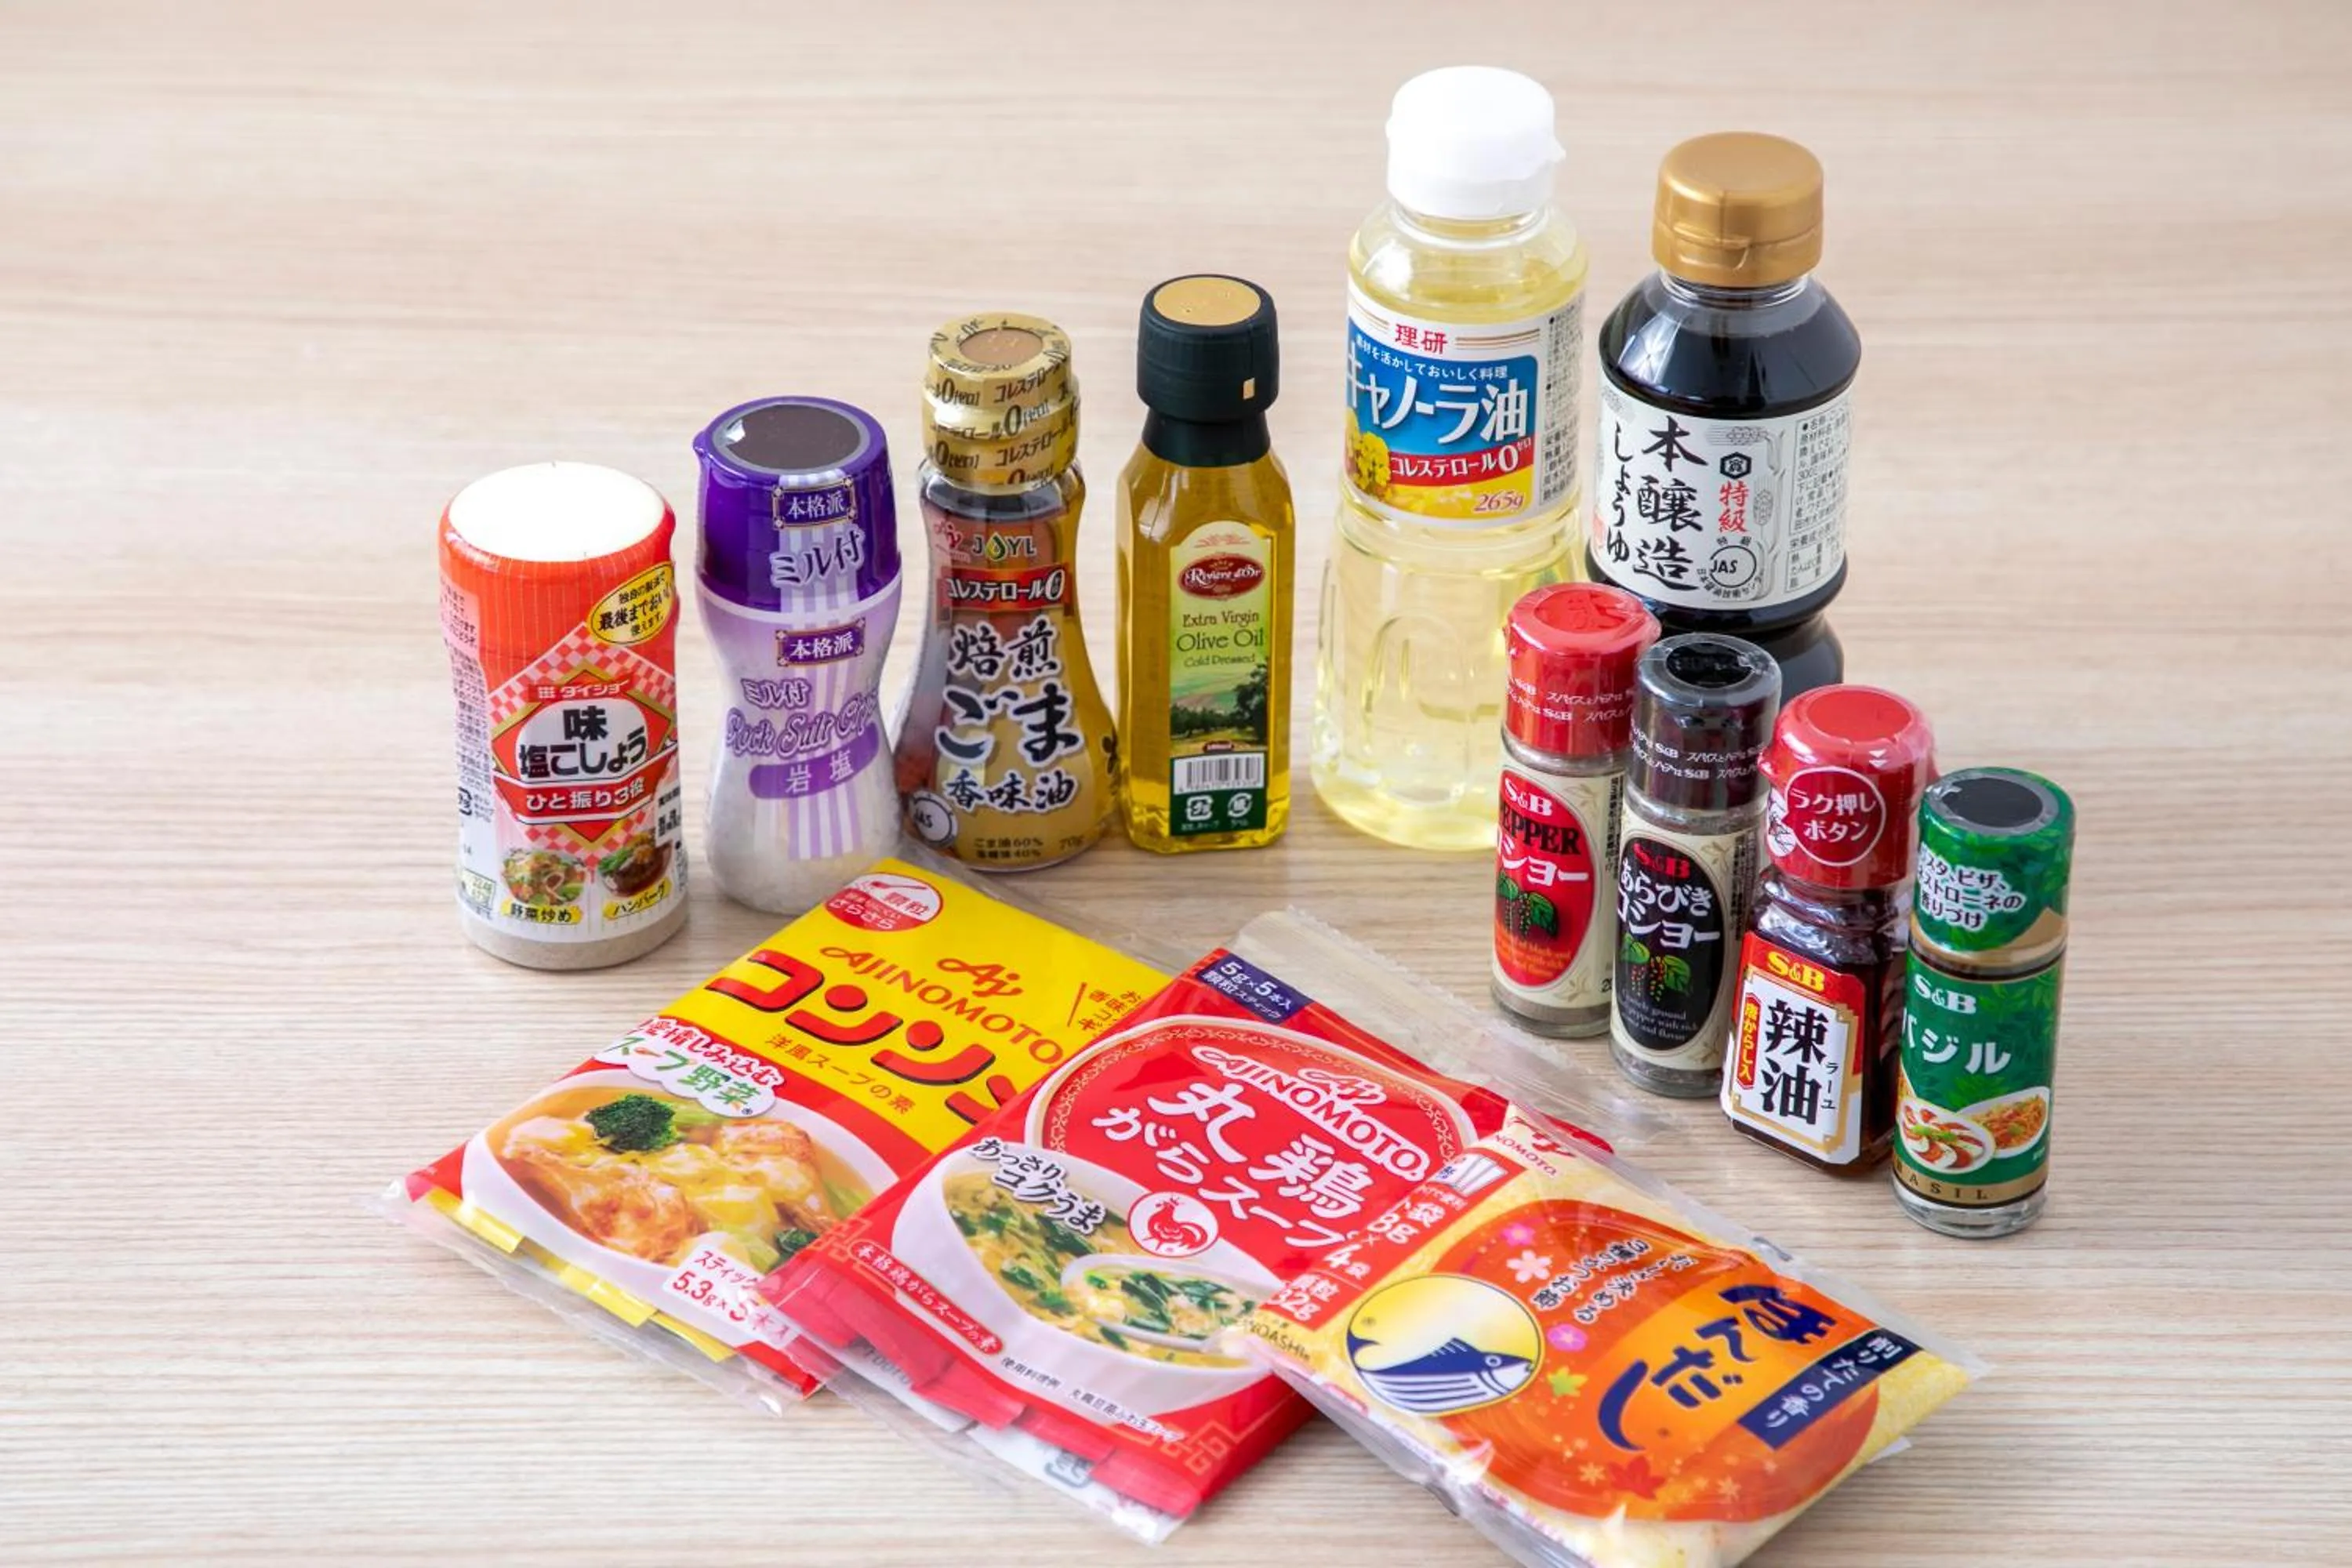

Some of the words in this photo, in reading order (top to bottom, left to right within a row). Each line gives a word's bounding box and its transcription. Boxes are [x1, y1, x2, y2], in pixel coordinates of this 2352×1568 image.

[1396, 323, 1448, 354] 理研
[1346, 340, 1528, 444] キャノーラ油
[1392, 445, 1519, 477] コレステロール0
[787, 491, 845, 519] 本格派
[1473, 489, 1525, 513] 265g
[1607, 421, 1633, 562] しょうゆ
[1633, 415, 1709, 591] 本醸造
[1719, 481, 1750, 532] 特級
[774, 530, 861, 583] ミル付
[1710, 559, 1737, 574] JAS
[947, 570, 1065, 601] コレステロール0
[1177, 632, 1229, 652] Olive
[1234, 627, 1264, 648] Oil
[1182, 614, 1217, 627] Extra
[1221, 609, 1259, 628] Virgin
[790, 631, 854, 659] 本格派
[949, 617, 1058, 677] 焙煎
[743, 680, 809, 707] ミル付
[563, 706, 607, 741] 味
[778, 712, 835, 759] Salt
[938, 683, 1080, 762] ごま
[519, 726, 647, 778] 塩こしょう
[786, 750, 855, 793] 岩塩
[526, 780, 644, 811] ひと振り3役
[946, 770, 1075, 810] 香味油
[1504, 778, 1553, 816] S&B
[1790, 787, 1876, 816] ラク押し
[1501, 800, 1581, 855] EPPER
[1804, 820, 1868, 843] ボタン
[614, 883, 665, 916] ハンバーグ
[1621, 857, 1712, 916] あらびき
[1922, 891, 1982, 929] 香りづけ
[1766, 950, 1825, 992] S&B
[820, 947, 1063, 1065] AJINOMOTO
[1914, 974, 1976, 1014] S&B
[765, 1034, 917, 1116] 洋風スープの素
[1759, 998, 1829, 1125] 辣油
[1820, 1062, 1839, 1110] ラーユ
[1191, 1045, 1431, 1181] AJINOMOTO
[973, 1138, 1064, 1180] あっさり
[1147, 1082, 1374, 1219] 丸鶏
[1091, 1107, 1359, 1247] がらスープ
[993, 1168, 1103, 1231] コクうま
[1598, 1284, 1838, 1451] ほんだし
[1766, 1336, 1902, 1429] 削りたての香り
